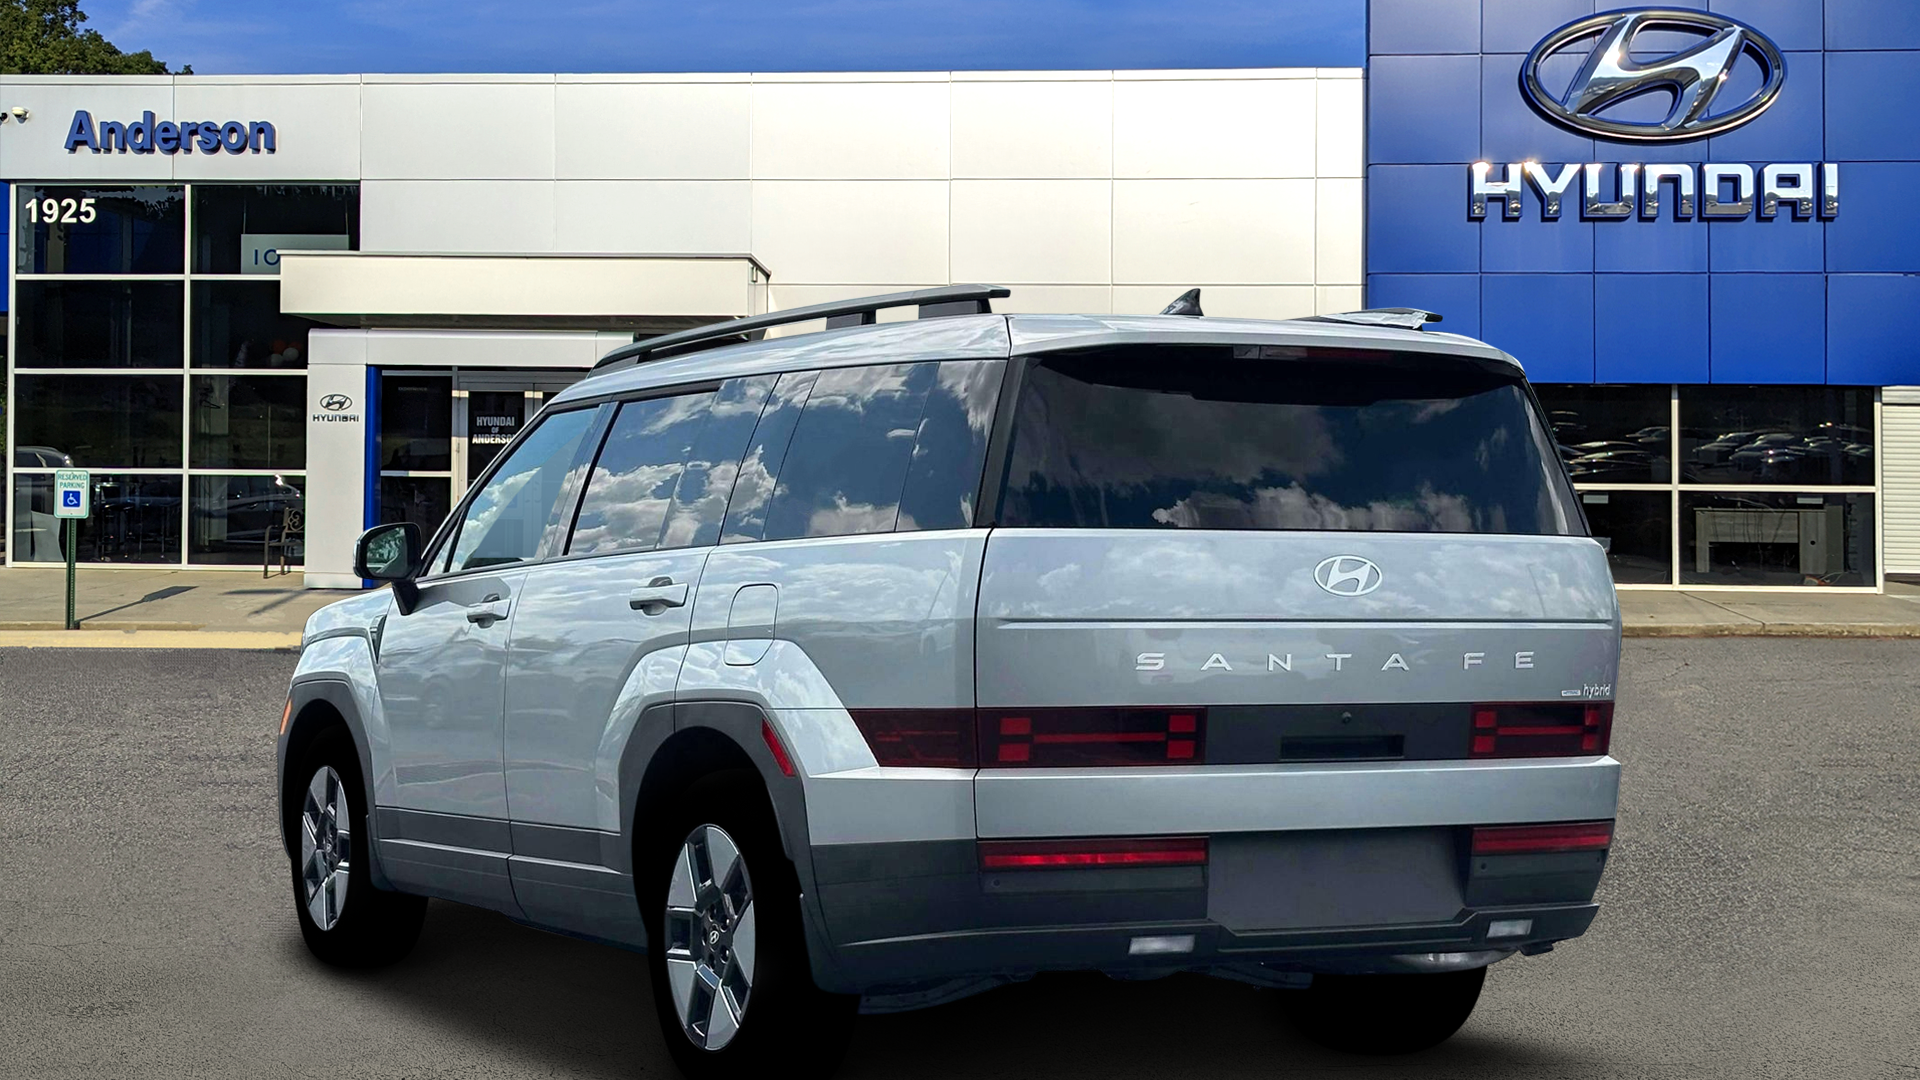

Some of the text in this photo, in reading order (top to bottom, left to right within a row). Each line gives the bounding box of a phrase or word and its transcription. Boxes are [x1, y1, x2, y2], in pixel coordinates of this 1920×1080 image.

[64, 110, 276, 154] Anderson
[1468, 161, 1839, 221] HYUNDAI
[25, 198, 96, 224] 1925
[312, 414, 360, 422] HYUNDAI
[476, 416, 515, 426] HYUNDAI
[1135, 652, 1534, 671] SANTA FE
[1583, 683, 1611, 699] hybrid
